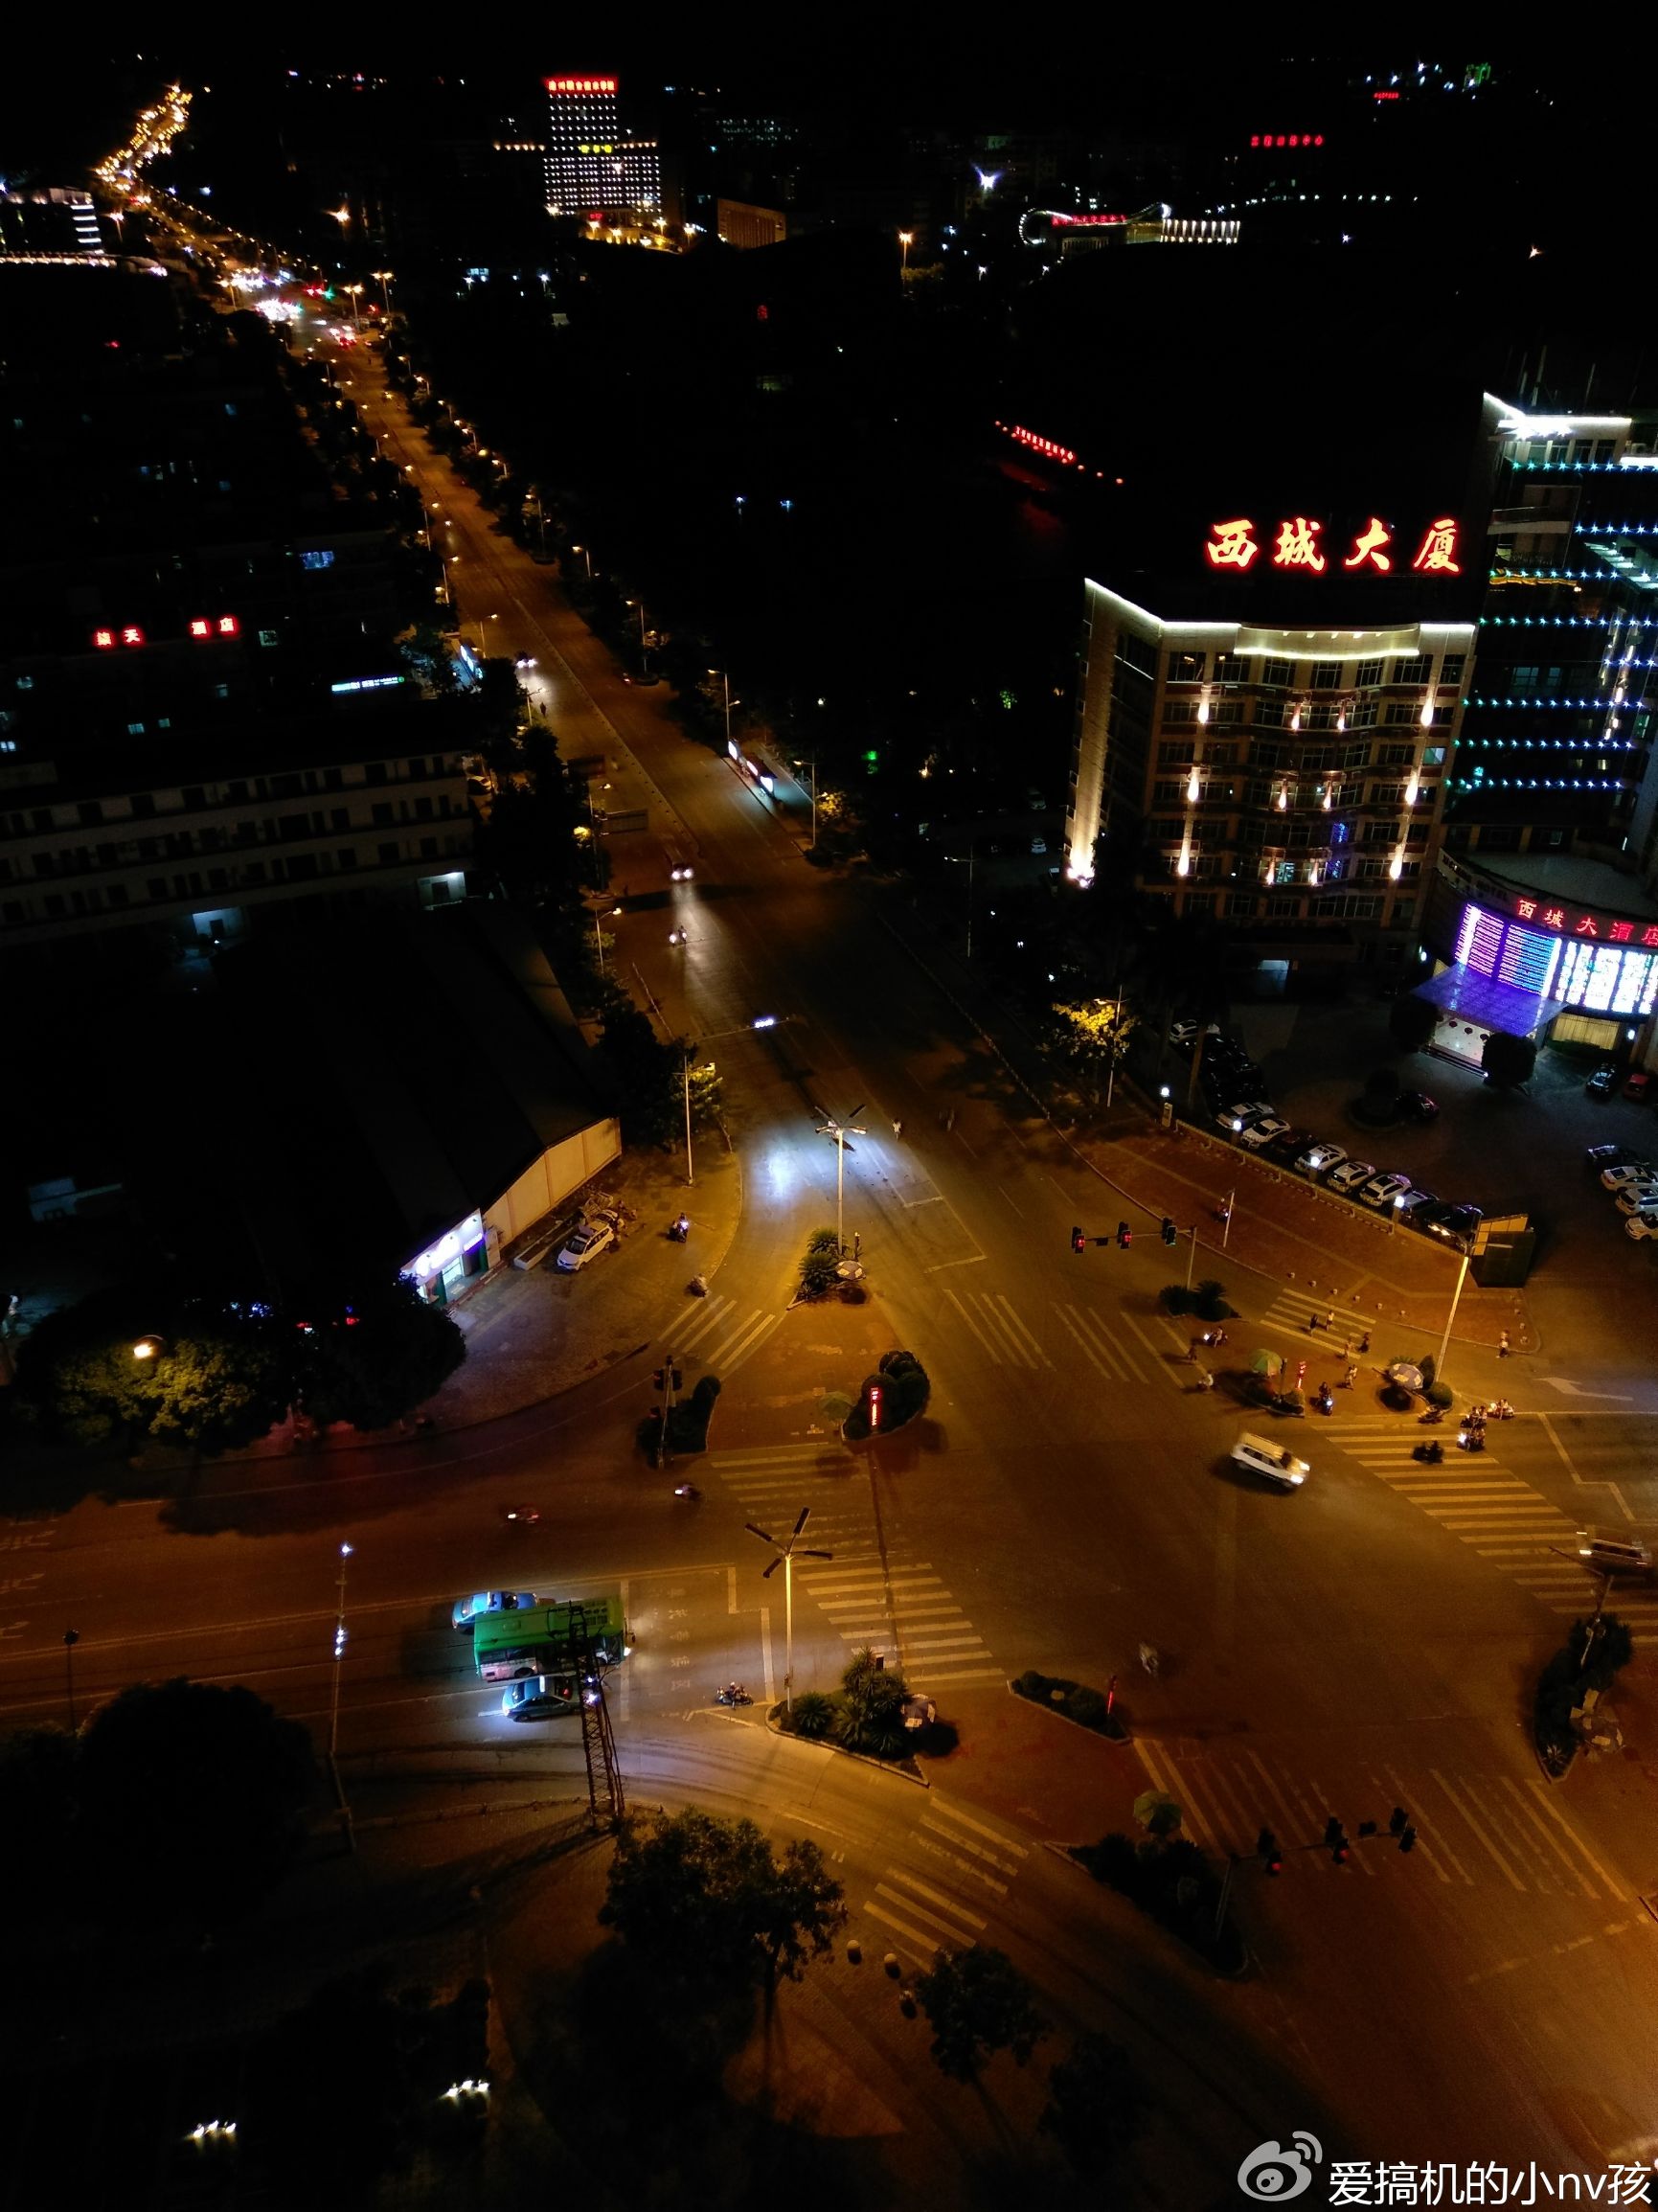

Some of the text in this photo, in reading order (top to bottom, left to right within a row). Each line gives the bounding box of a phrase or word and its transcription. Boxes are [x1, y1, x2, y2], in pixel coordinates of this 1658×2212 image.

[1206, 516, 1461, 573] 西城大厦
[1518, 899, 1658, 946] 西城大酒店
